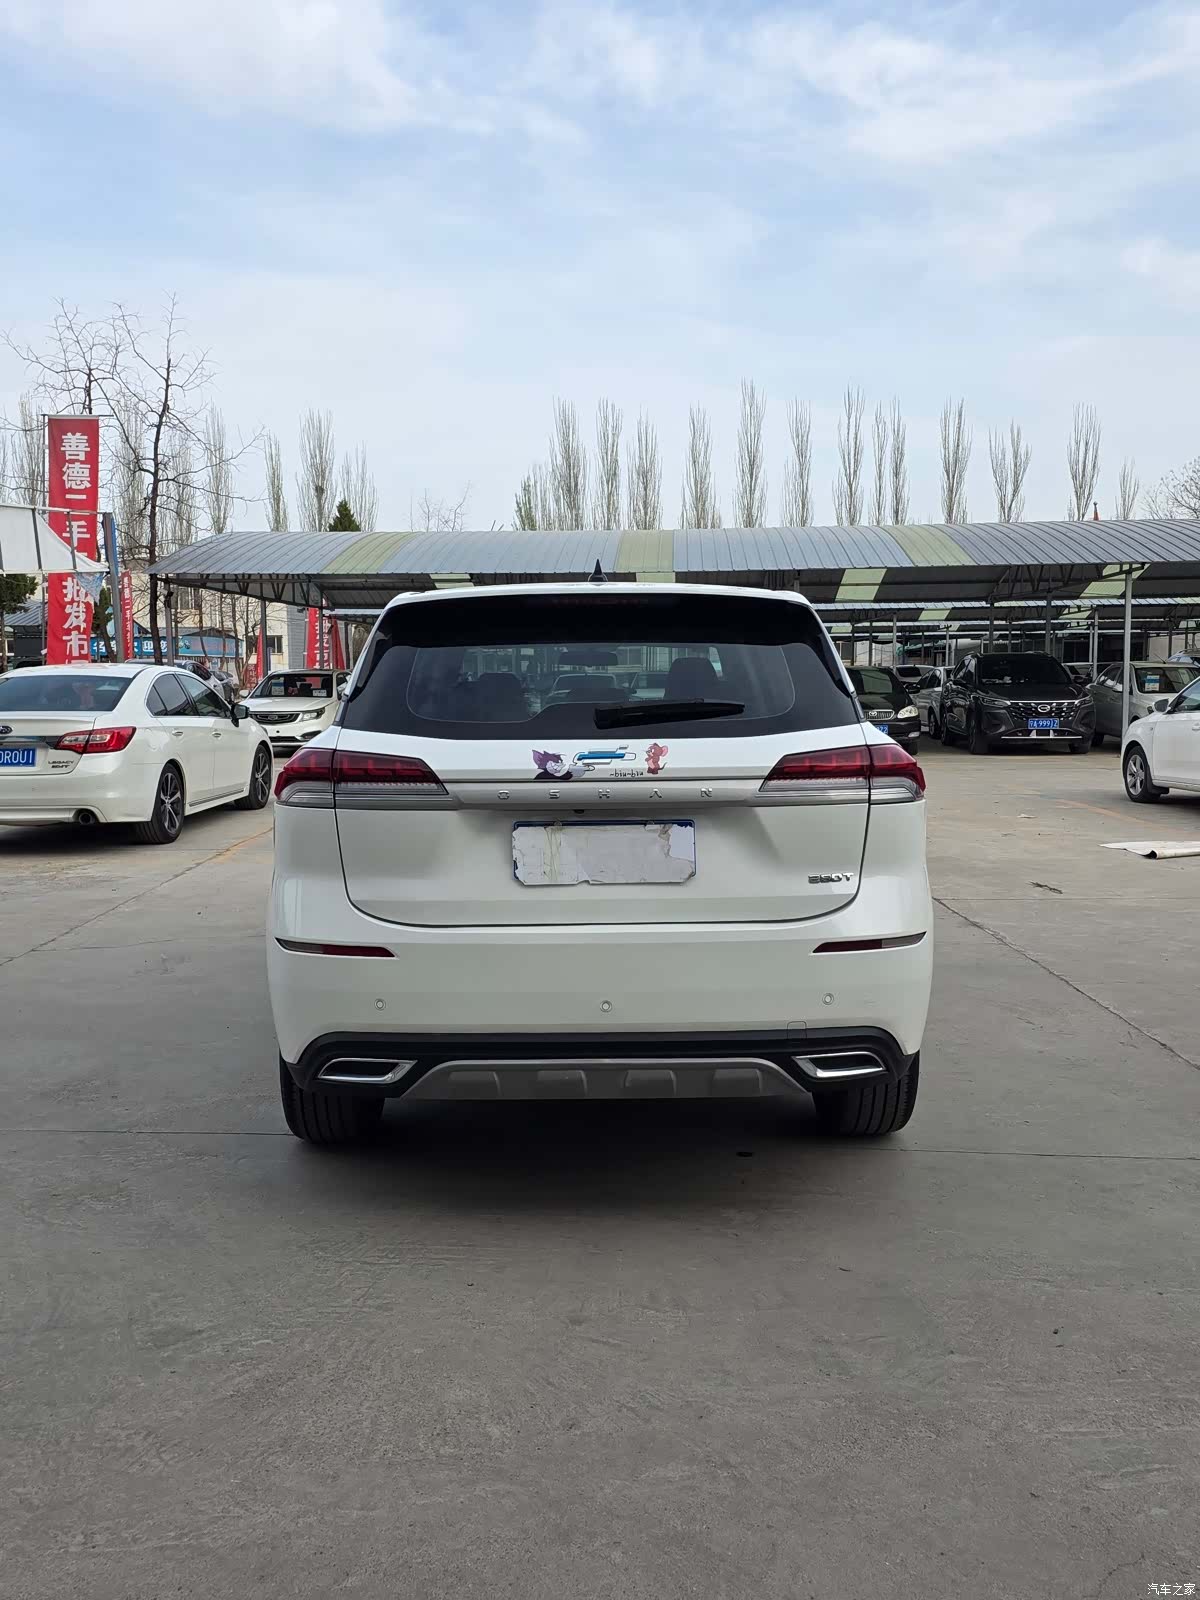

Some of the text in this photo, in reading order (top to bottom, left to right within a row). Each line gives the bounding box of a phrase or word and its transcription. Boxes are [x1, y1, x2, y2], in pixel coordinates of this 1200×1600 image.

[61, 432, 91, 664] 善德二手批发市
[497, 787, 713, 800] OSHAN
